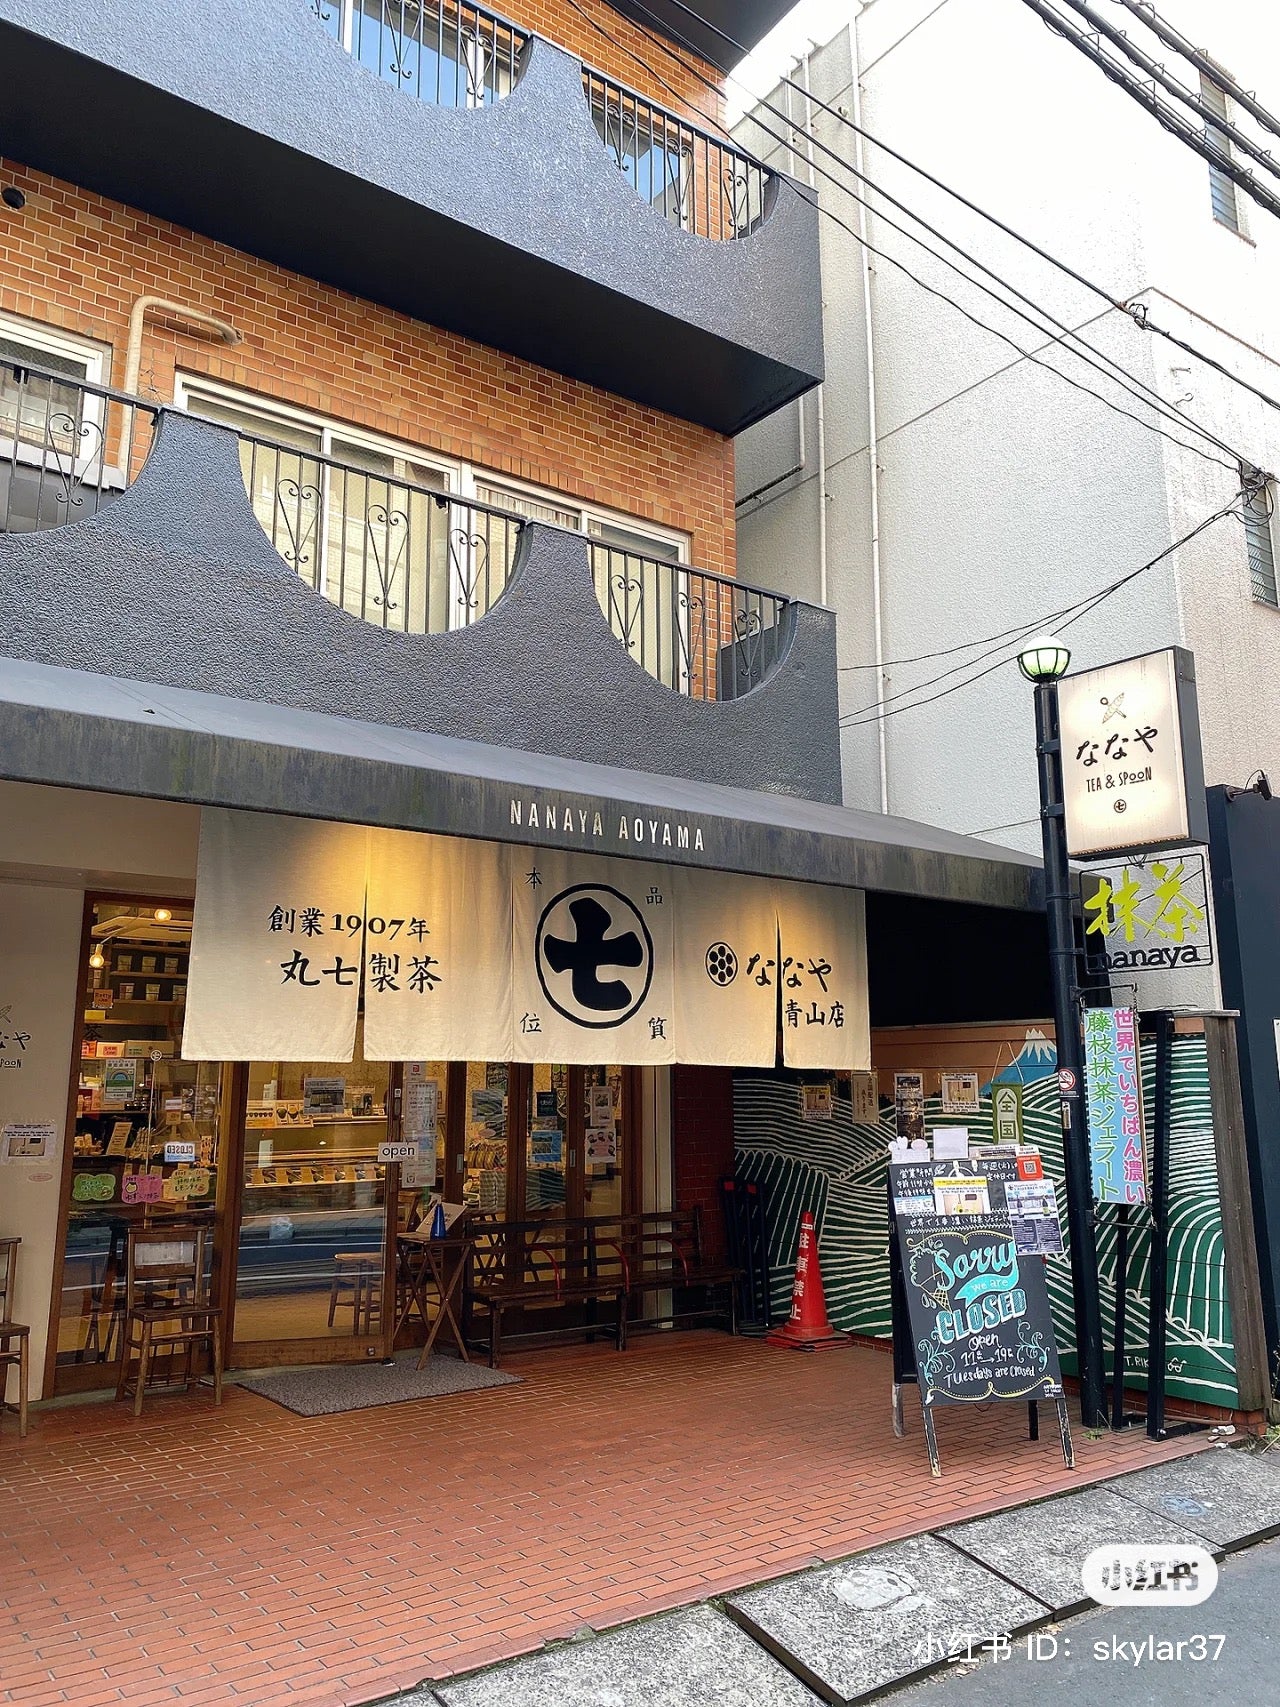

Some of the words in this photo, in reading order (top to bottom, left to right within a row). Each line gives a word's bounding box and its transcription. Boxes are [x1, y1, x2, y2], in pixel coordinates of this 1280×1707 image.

[1076, 725, 1158, 768] ななや
[1086, 776, 1103, 793] TEA
[1105, 774, 1116, 790] &
[510, 799, 604, 837] NANAYA
[618, 815, 705, 852] AOYAMA
[524, 866, 543, 890] 本
[645, 886, 665, 906] 品
[1084, 863, 1205, 943] 抹茶
[267, 904, 432, 943] 創業1907年
[279, 948, 443, 994] 丸七製茶
[746, 952, 832, 993] ななや
[519, 1011, 543, 1034] 位
[647, 1016, 668, 1041] 質
[784, 999, 846, 1029] 青山店
[0, 1057, 22, 1069] POON
[1085, 1009, 1121, 1201] 藤枝抹茶ジェラート
[1113, 1007, 1145, 1204] 世界でいちばん濃い
[382, 1145, 415, 1158] open
[934, 1241, 1019, 1291] Sorry
[935, 1288, 1028, 1345] CLOSED
[1123, 1355, 1149, 1369] T.RIK
